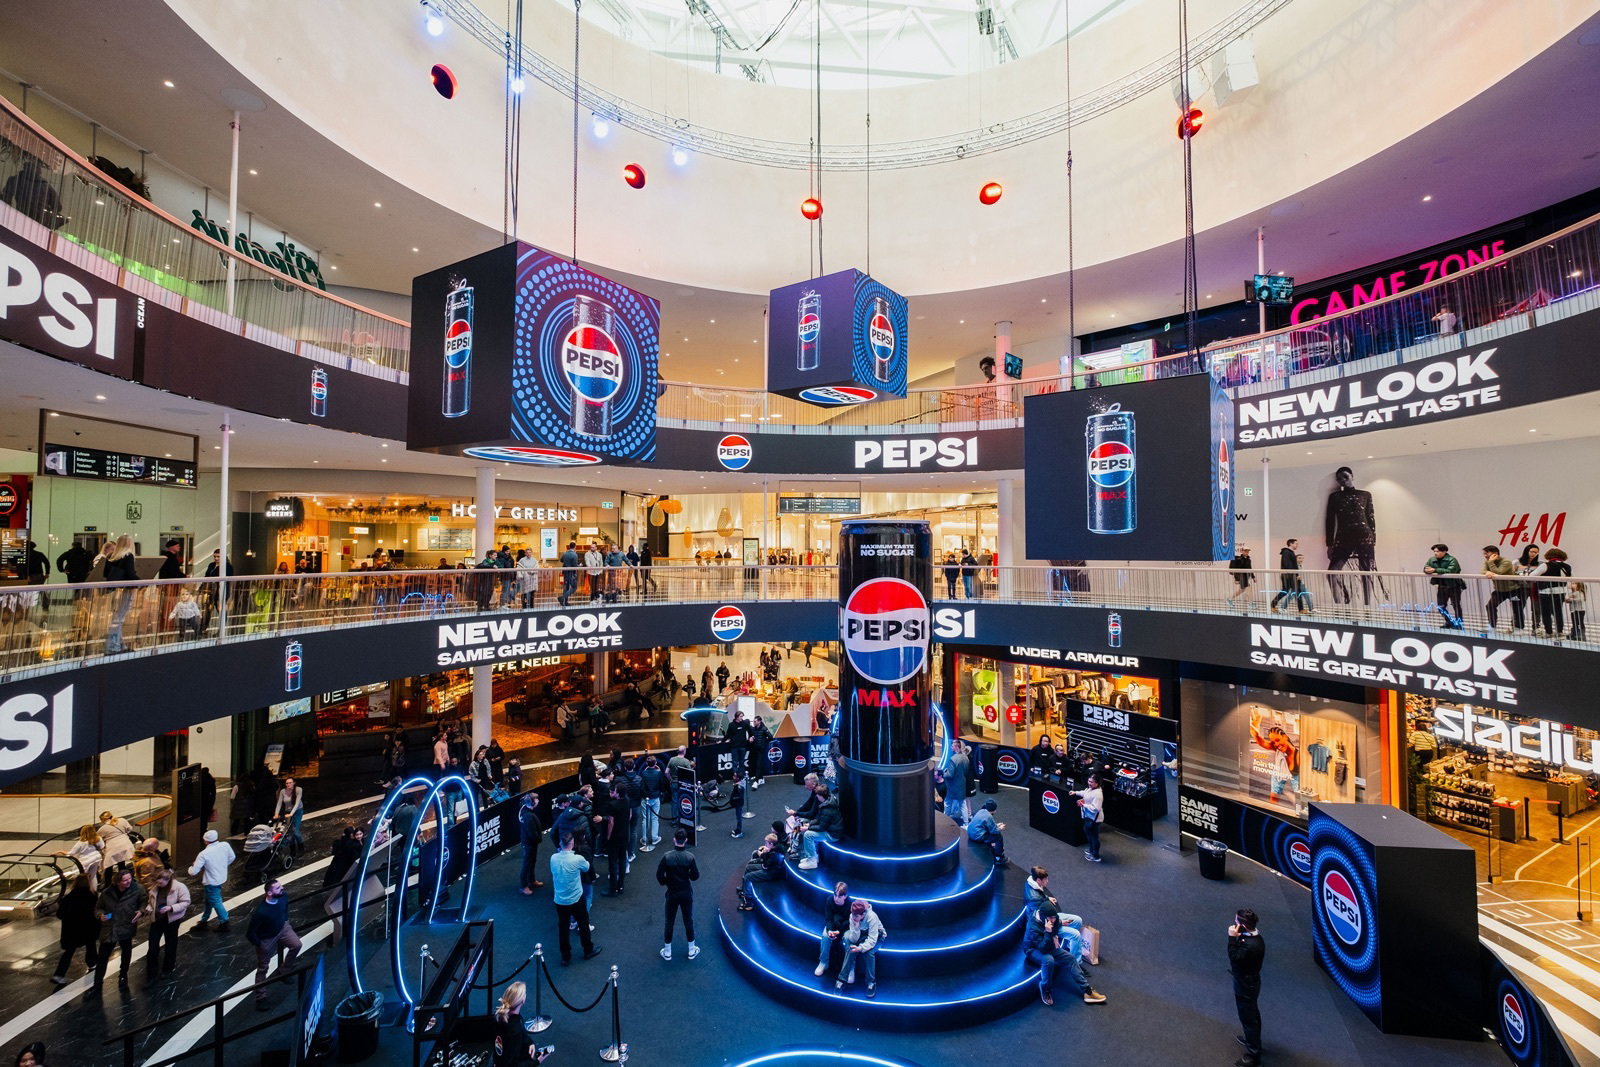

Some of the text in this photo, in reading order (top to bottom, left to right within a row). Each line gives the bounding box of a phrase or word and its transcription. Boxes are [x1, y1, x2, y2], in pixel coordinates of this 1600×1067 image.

[1290, 239, 1506, 331] GAME ZONE
[137, 297, 145, 329] OCEAN
[799, 322, 819, 332] PEPSI
[871, 328, 893, 347] PEPSI
[446, 337, 470, 352] PEPSI
[566, 348, 619, 377] PEPSI
[1239, 347, 1500, 426] NEW LOOK
[1239, 384, 1501, 443] SAME GREAT TASTE
[719, 447, 750, 457] PEPSI
[854, 436, 978, 468] PEPSI
[1091, 459, 1131, 470] PEPSI
[1097, 490, 1127, 499] MAX
[452, 503, 577, 521] HOY GREENS
[1498, 512, 1567, 547] H&M
[438, 611, 623, 648] NEW LOOK
[713, 619, 744, 627] PEPSI
[848, 618, 926, 641] PEPSI
[437, 634, 623, 666] SAME GREAT TASTE
[1009, 645, 1140, 668] UNDER ARMOUR
[1250, 623, 1516, 681] NEW LOOK
[521, 656, 561, 669] NERO
[1250, 651, 1518, 705] SAME GREAT TASTE
[858, 688, 917, 708] MAX
[1083, 704, 1130, 726] PEPSI
[1083, 716, 1130, 731] MERCH SHOP
[1253, 759, 1267, 768] Join
[1043, 795, 1060, 807] PEPSI
[1181, 795, 1218, 816] SAME
[1181, 805, 1218, 823] GREAT
[1181, 813, 1218, 833] TASTE
[467, 834, 500, 854] ASTE
[1325, 887, 1359, 928] PEPSI
[1504, 1004, 1523, 1033] PEPSI
